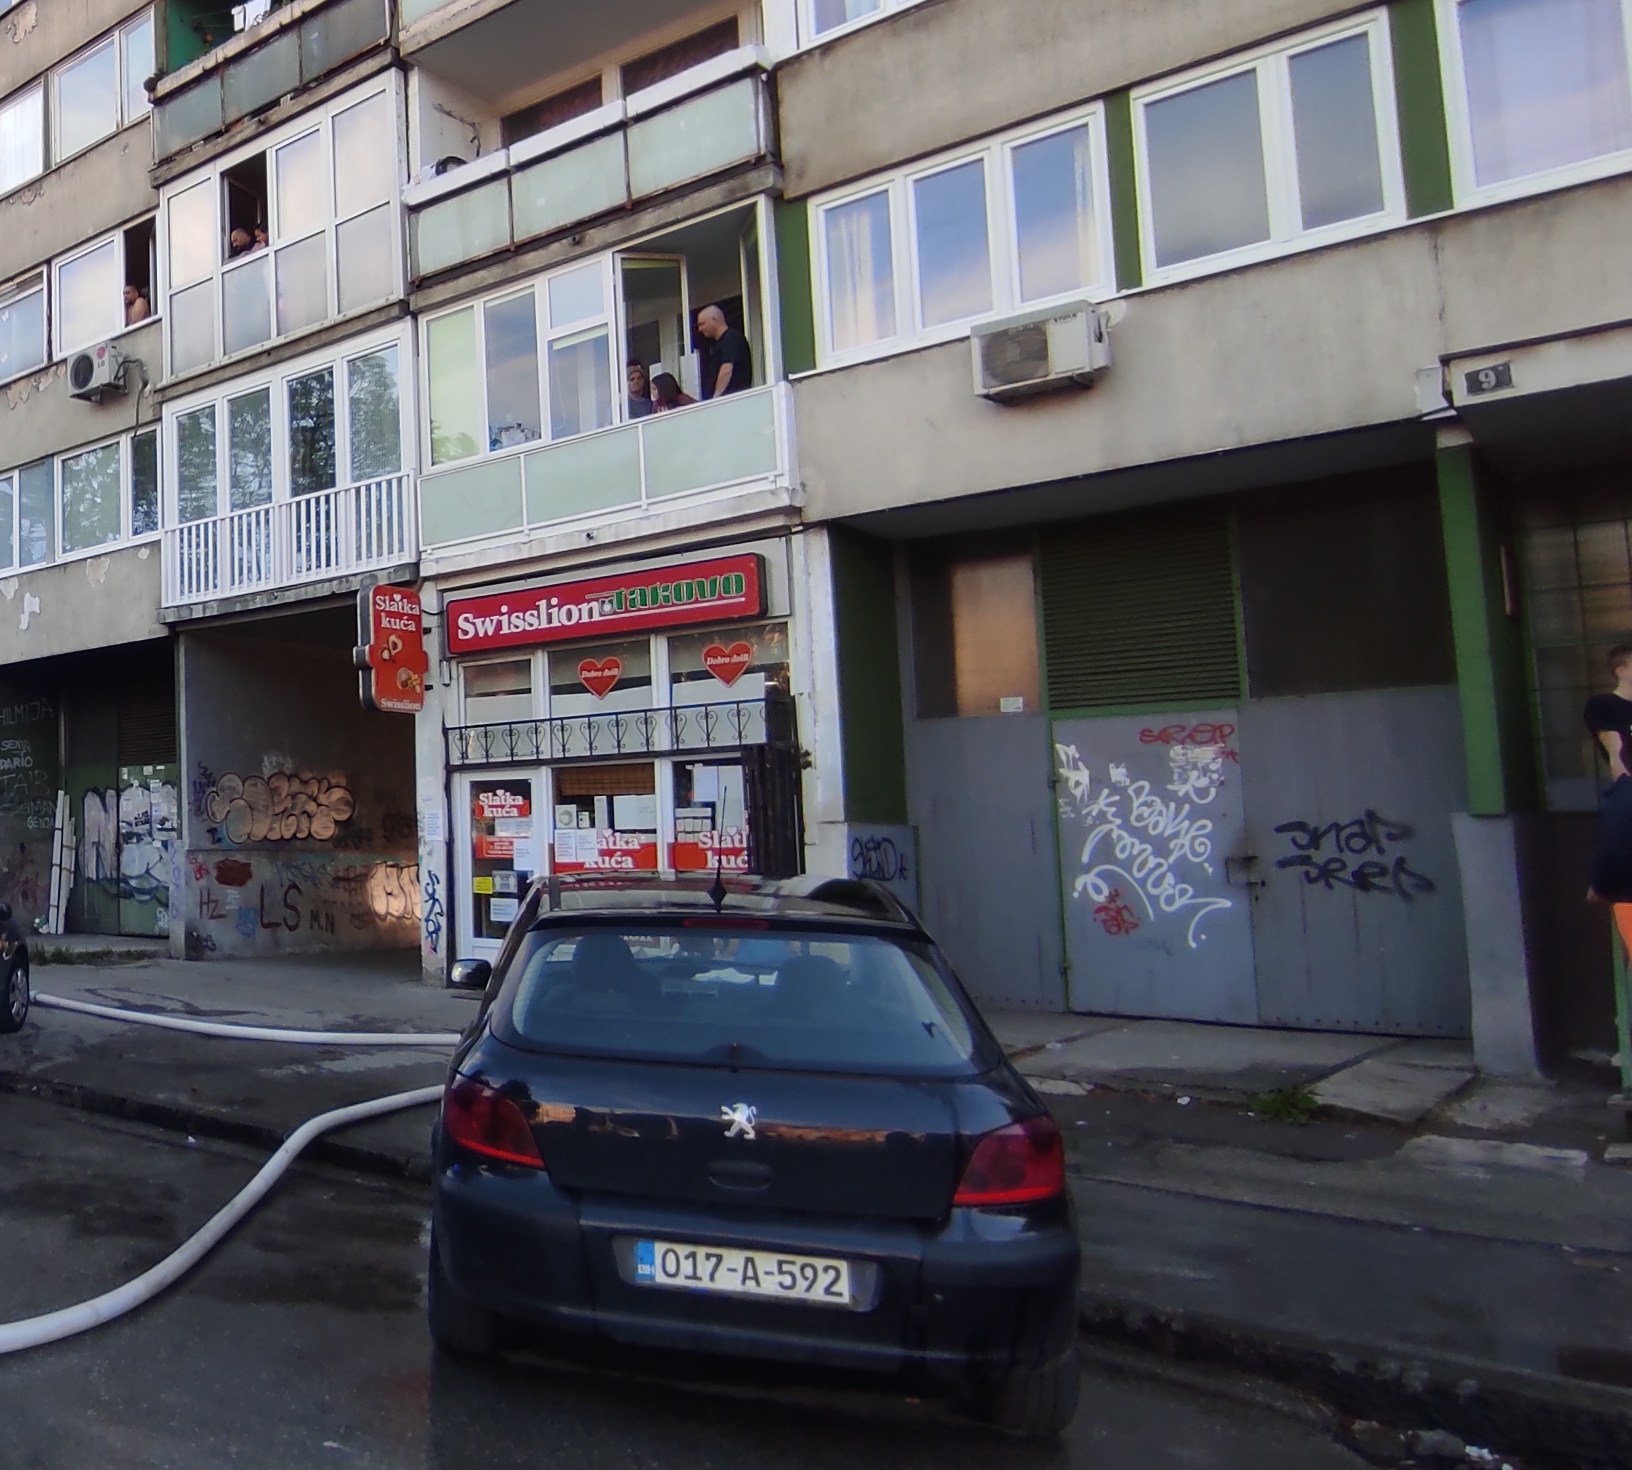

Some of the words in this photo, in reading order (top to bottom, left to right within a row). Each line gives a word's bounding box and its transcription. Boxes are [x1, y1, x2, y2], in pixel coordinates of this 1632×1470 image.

[1478, 369, 1497, 389] 9
[375, 594, 420, 615] Slatka
[380, 612, 417, 631] kuća
[457, 597, 601, 640] Swisslion
[479, 791, 524, 806] Slatka
[483, 803, 519, 818] kuća
[597, 832, 641, 850] atka
[704, 849, 749, 869] kuć
[660, 1247, 844, 1298] 017-A-592
